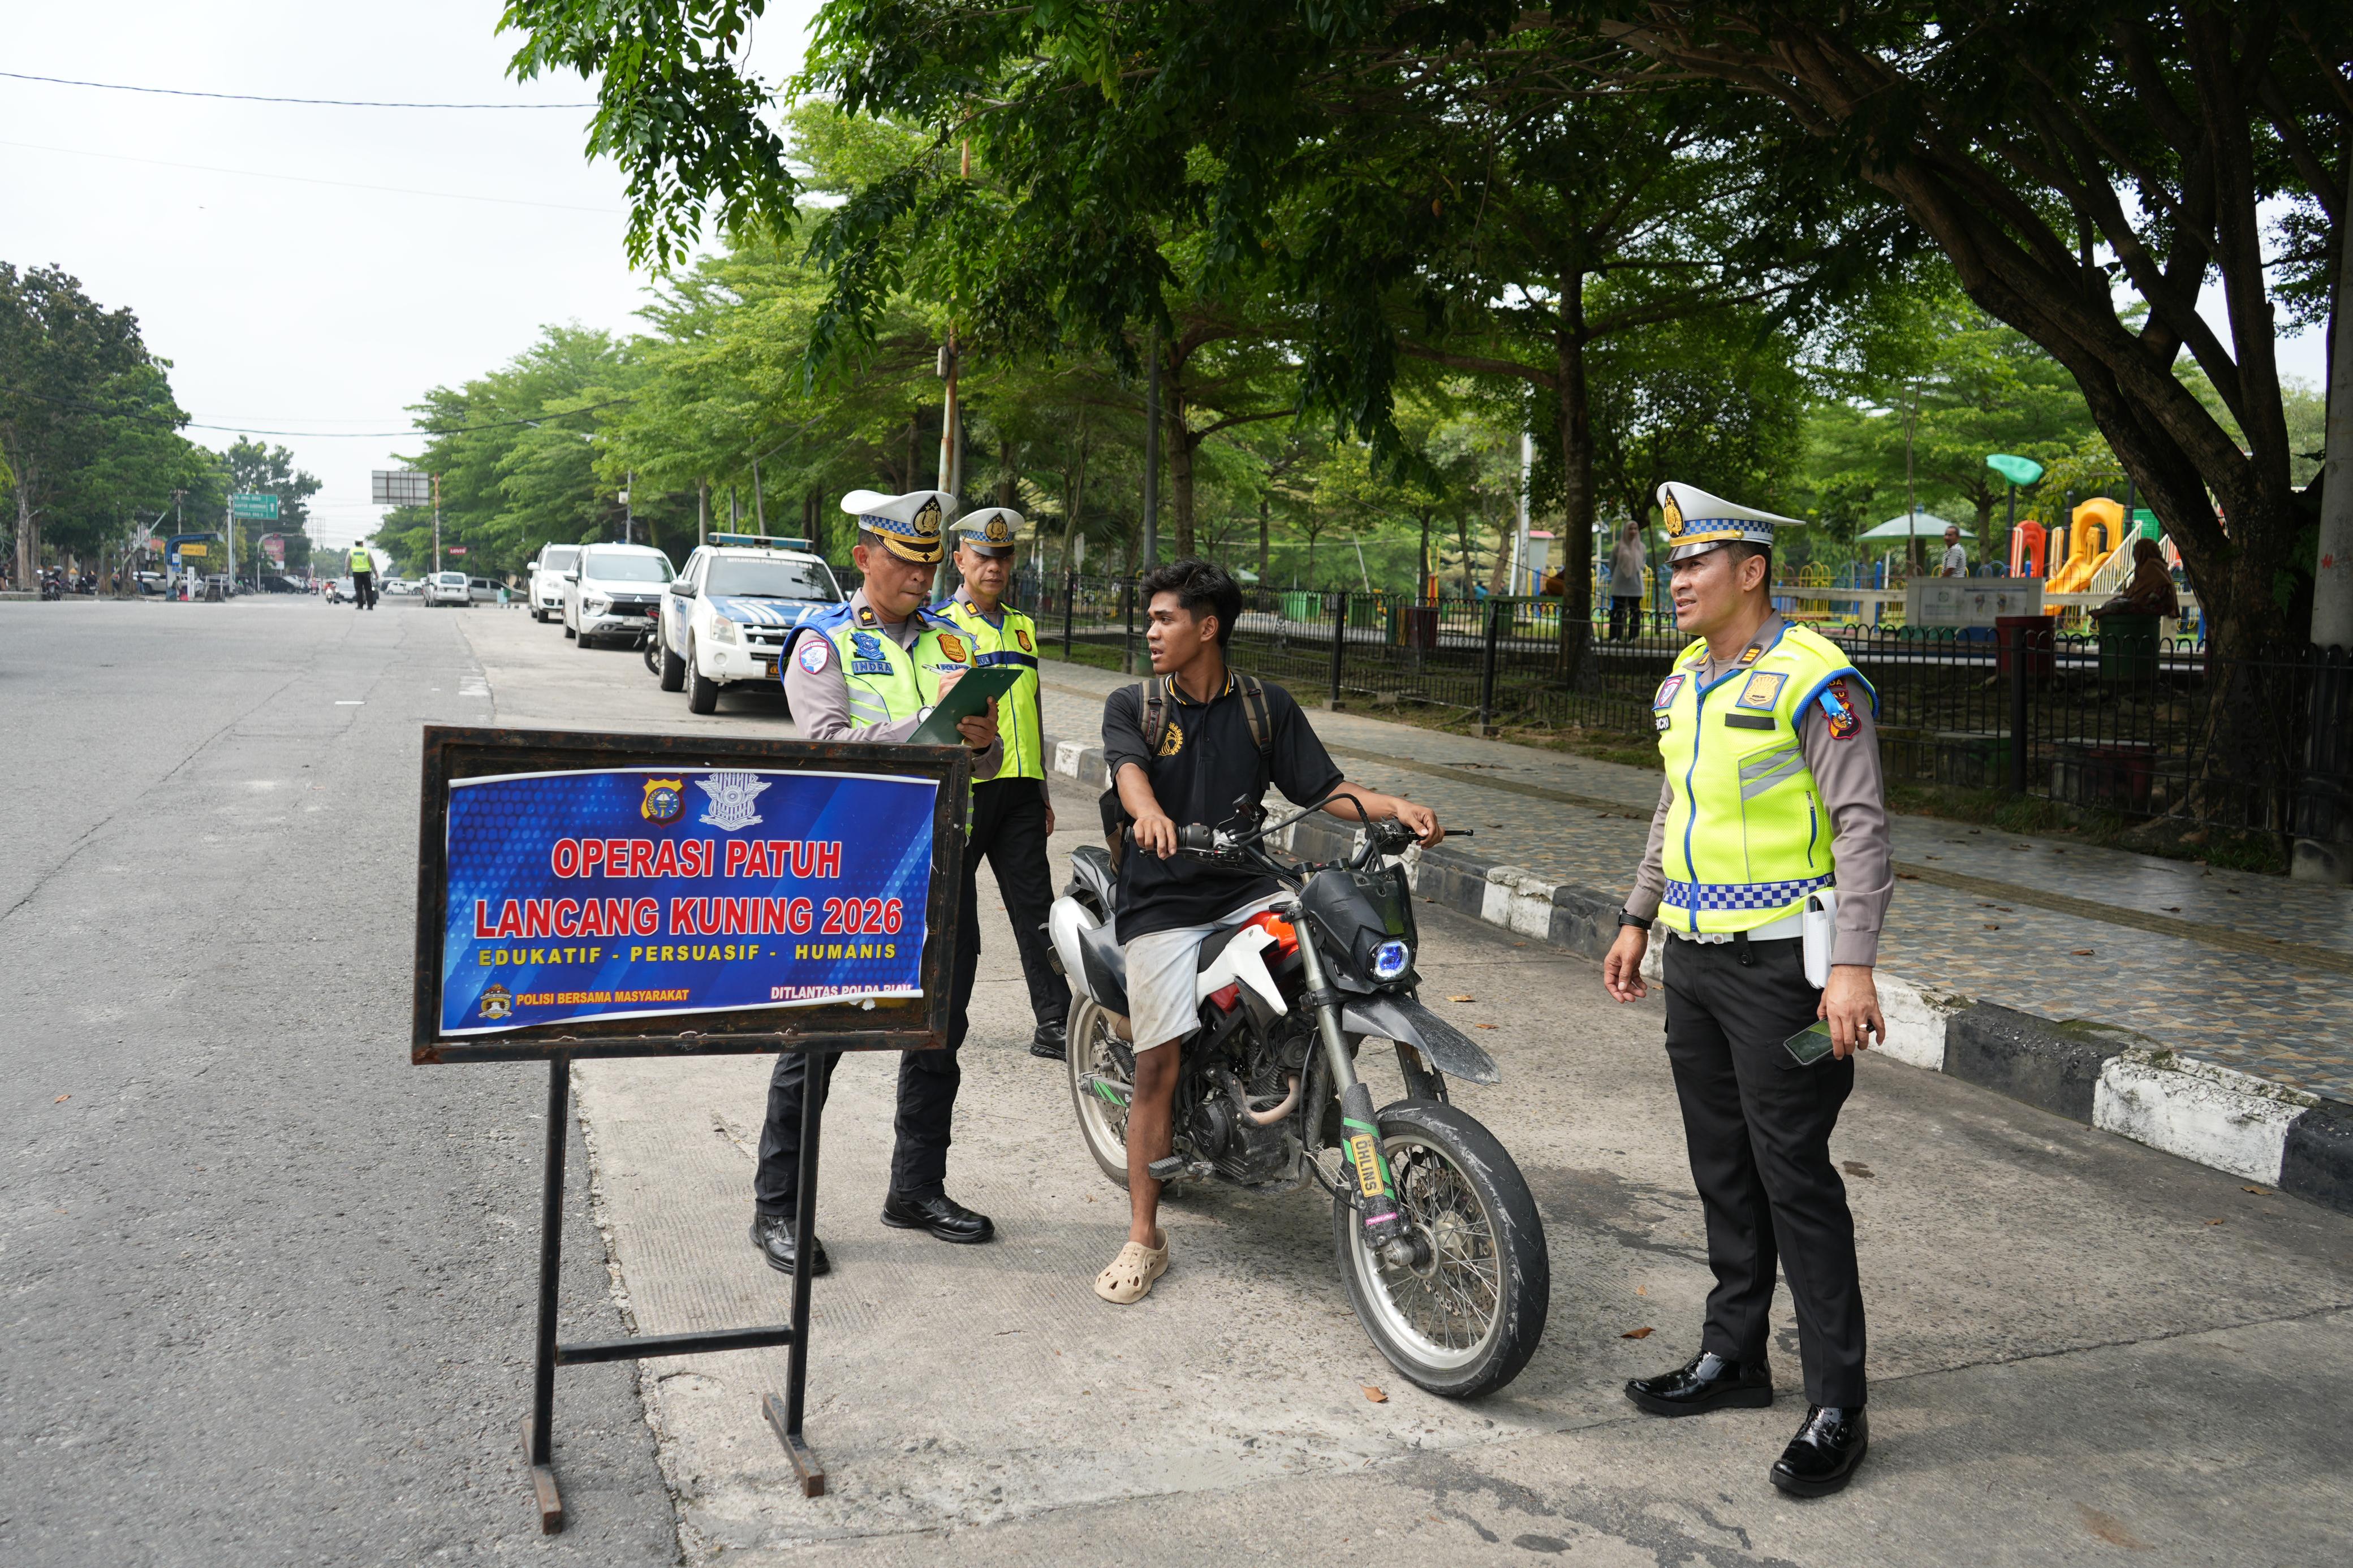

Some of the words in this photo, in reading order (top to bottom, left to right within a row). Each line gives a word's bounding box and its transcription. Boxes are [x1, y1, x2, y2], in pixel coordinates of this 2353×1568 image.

[800, 642, 811, 651] LALU
[855, 663, 892, 672] INDRA
[551, 837, 714, 879] OPERASI
[724, 839, 842, 879] PATUH
[474, 897, 659, 940] LANCANG
[669, 897, 813, 936] KUNING
[821, 897, 904, 936] 2026
[479, 947, 602, 967] EDUKATIF
[630, 944, 760, 963] PERSUASIF
[795, 943, 897, 961] HUMANIS
[516, 992, 554, 1006] POLISI
[557, 991, 611, 1005] BERSAMA
[615, 989, 689, 1002] MASYARAKAT
[770, 986, 838, 1000] DITLANTAS
[1355, 1139, 1377, 1191] ÖHLINS
